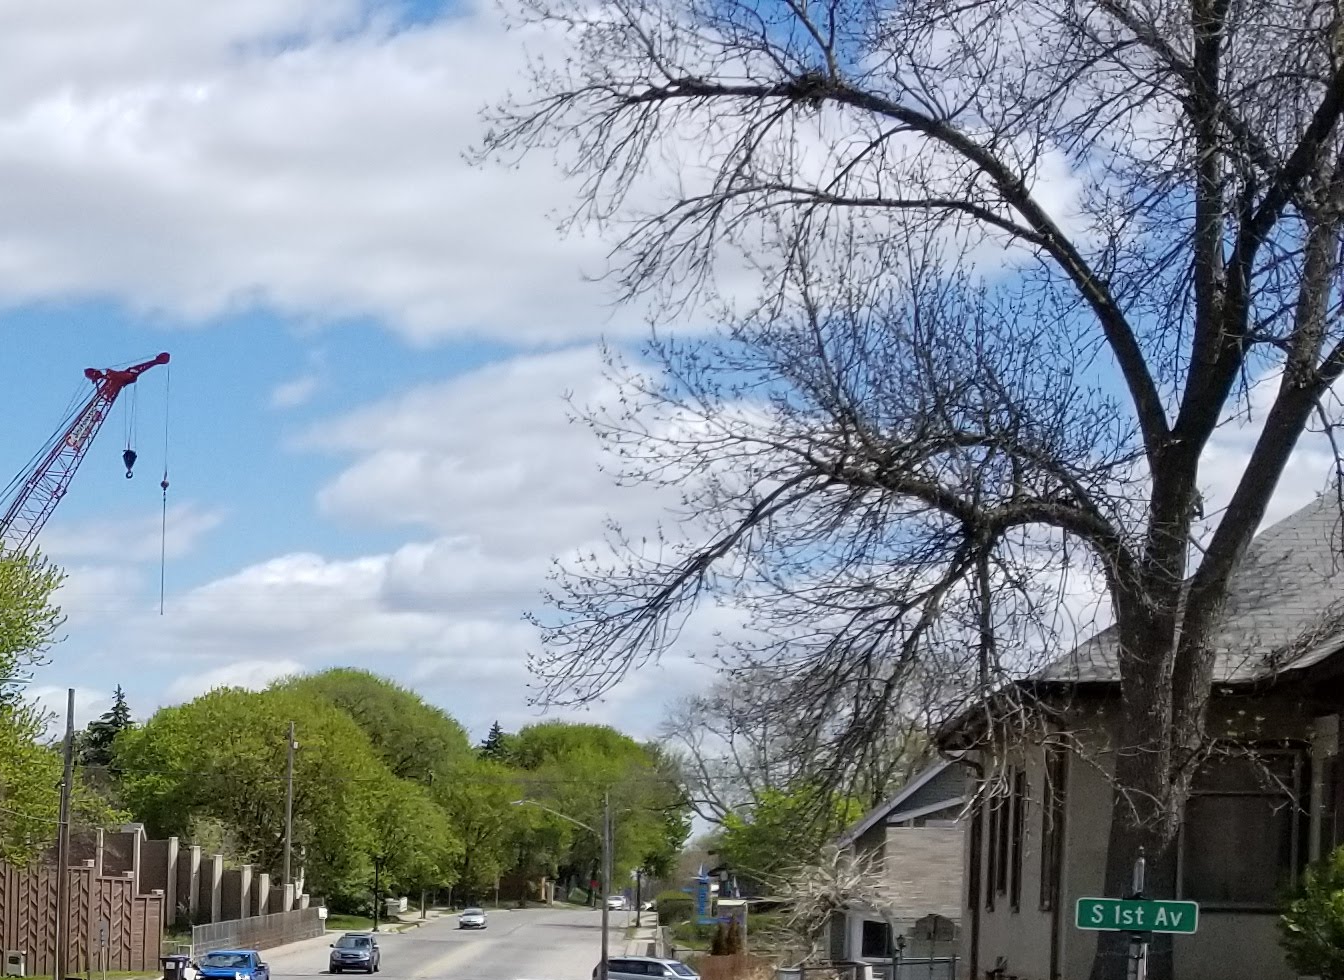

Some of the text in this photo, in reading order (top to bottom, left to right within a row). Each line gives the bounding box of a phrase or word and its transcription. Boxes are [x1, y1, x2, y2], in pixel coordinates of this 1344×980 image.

[1091, 904, 1182, 927] S 1st Av
